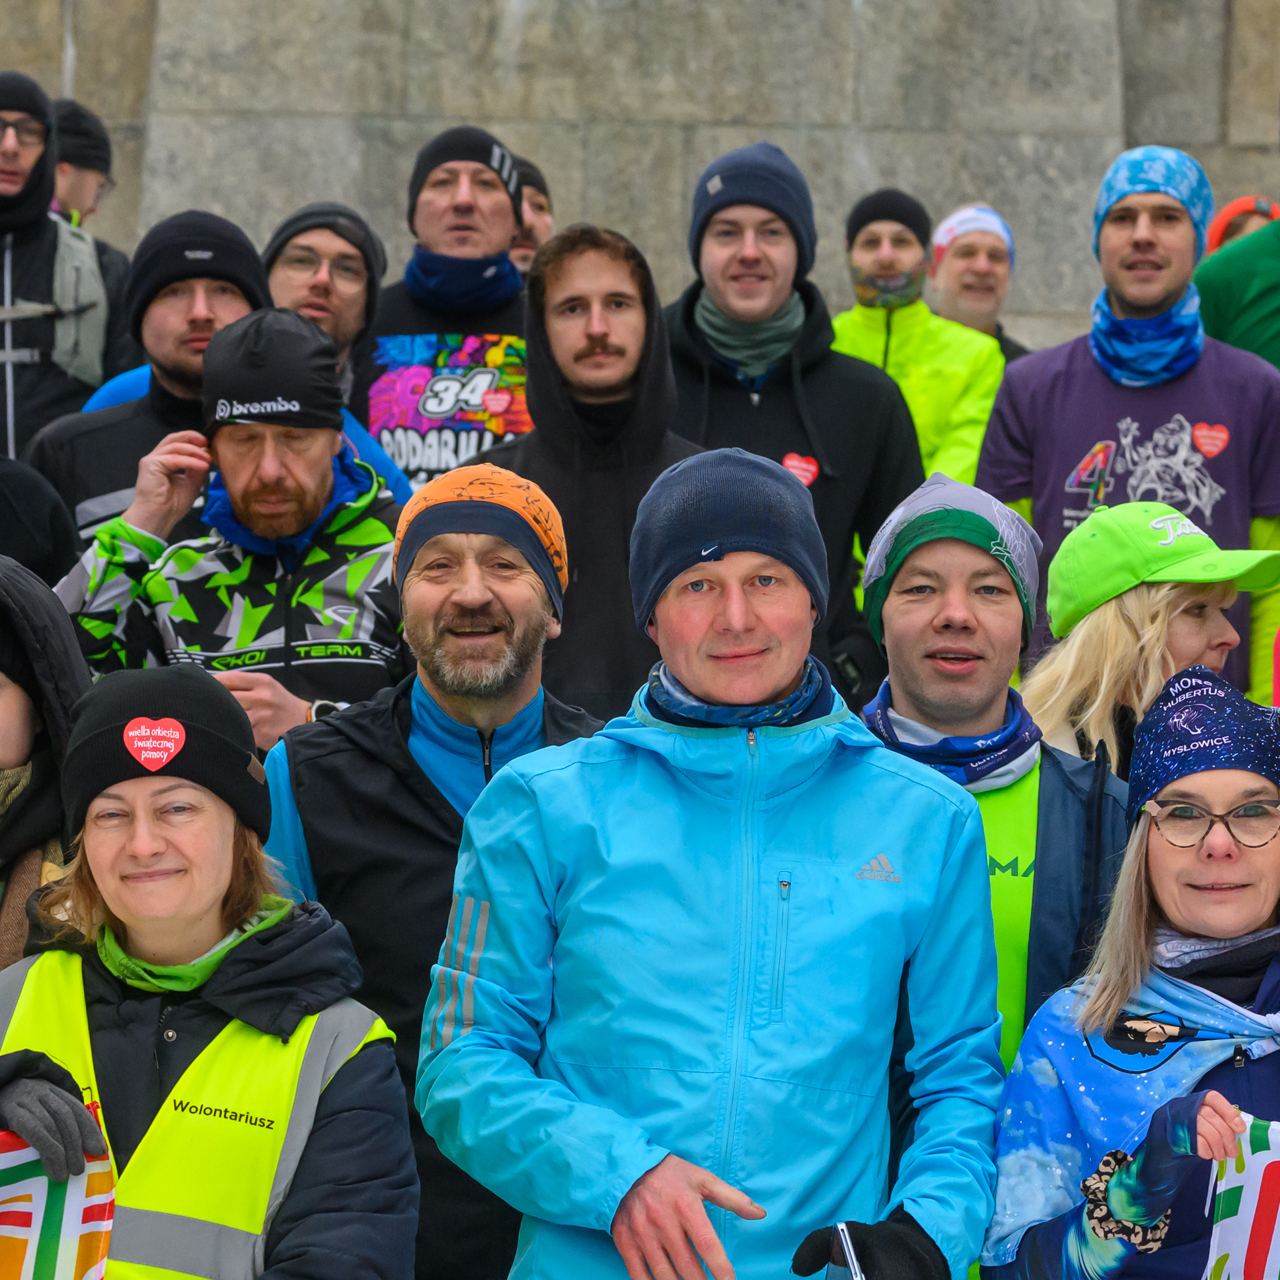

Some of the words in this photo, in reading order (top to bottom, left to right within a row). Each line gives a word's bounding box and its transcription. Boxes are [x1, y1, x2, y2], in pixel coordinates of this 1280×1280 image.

[420, 370, 498, 417] 34
[232, 396, 300, 416] brembo
[295, 644, 363, 658] TEAM
[1163, 687, 1226, 711] HUBERTUS
[128, 725, 150, 738] wielka
[151, 726, 180, 740] orkiestra
[133, 737, 175, 753] świątecznej
[141, 750, 168, 763] pomocy
[855, 870, 902, 884] adidas
[172, 1098, 276, 1131] Wolontariusz
